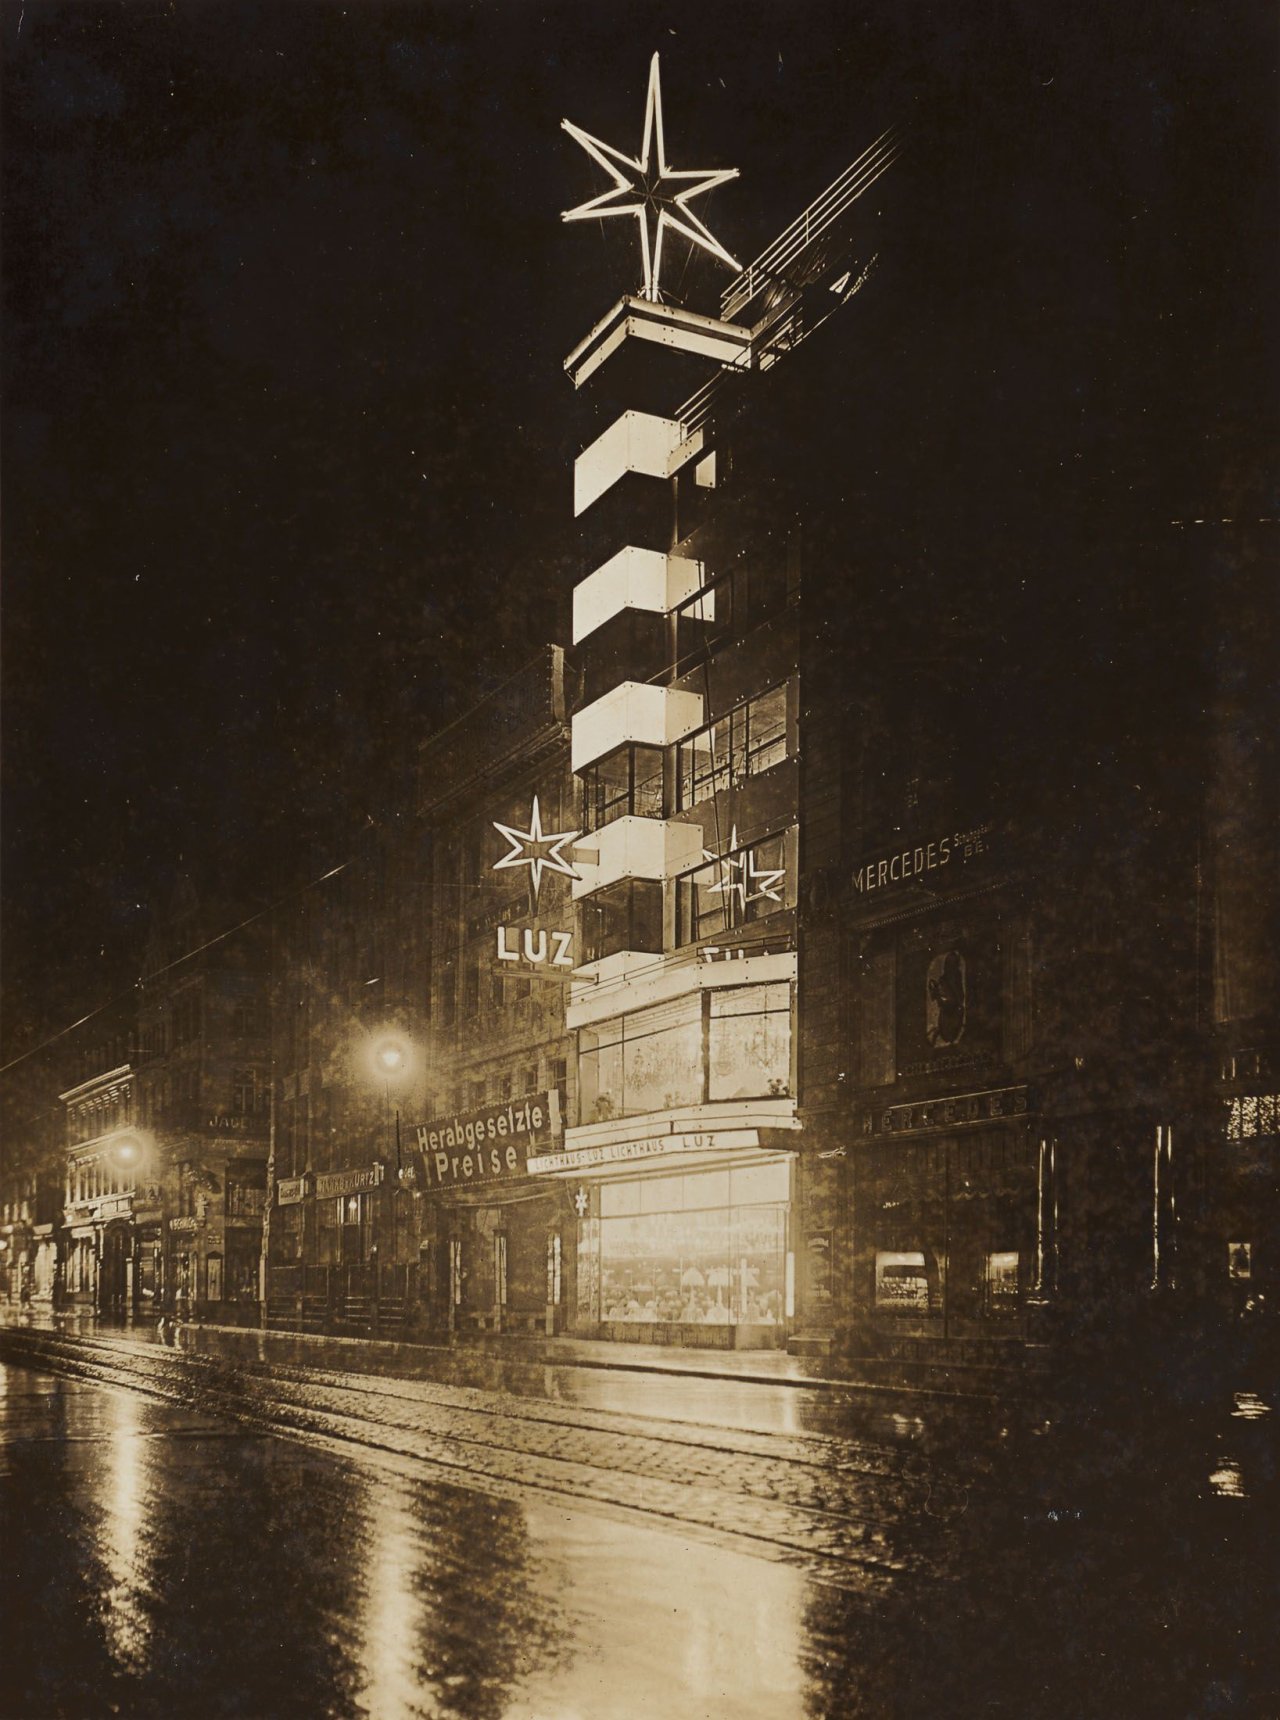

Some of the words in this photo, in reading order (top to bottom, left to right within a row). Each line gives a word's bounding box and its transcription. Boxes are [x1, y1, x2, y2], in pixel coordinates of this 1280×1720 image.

[851, 837, 951, 893] MERCEDES
[497, 926, 574, 965] LUZ
[416, 1101, 543, 1152] Herabgesetzte
[682, 1135, 715, 1149] LUZ
[435, 1144, 518, 1181] Preise
[610, 1139, 665, 1159] LICHTHAUS
